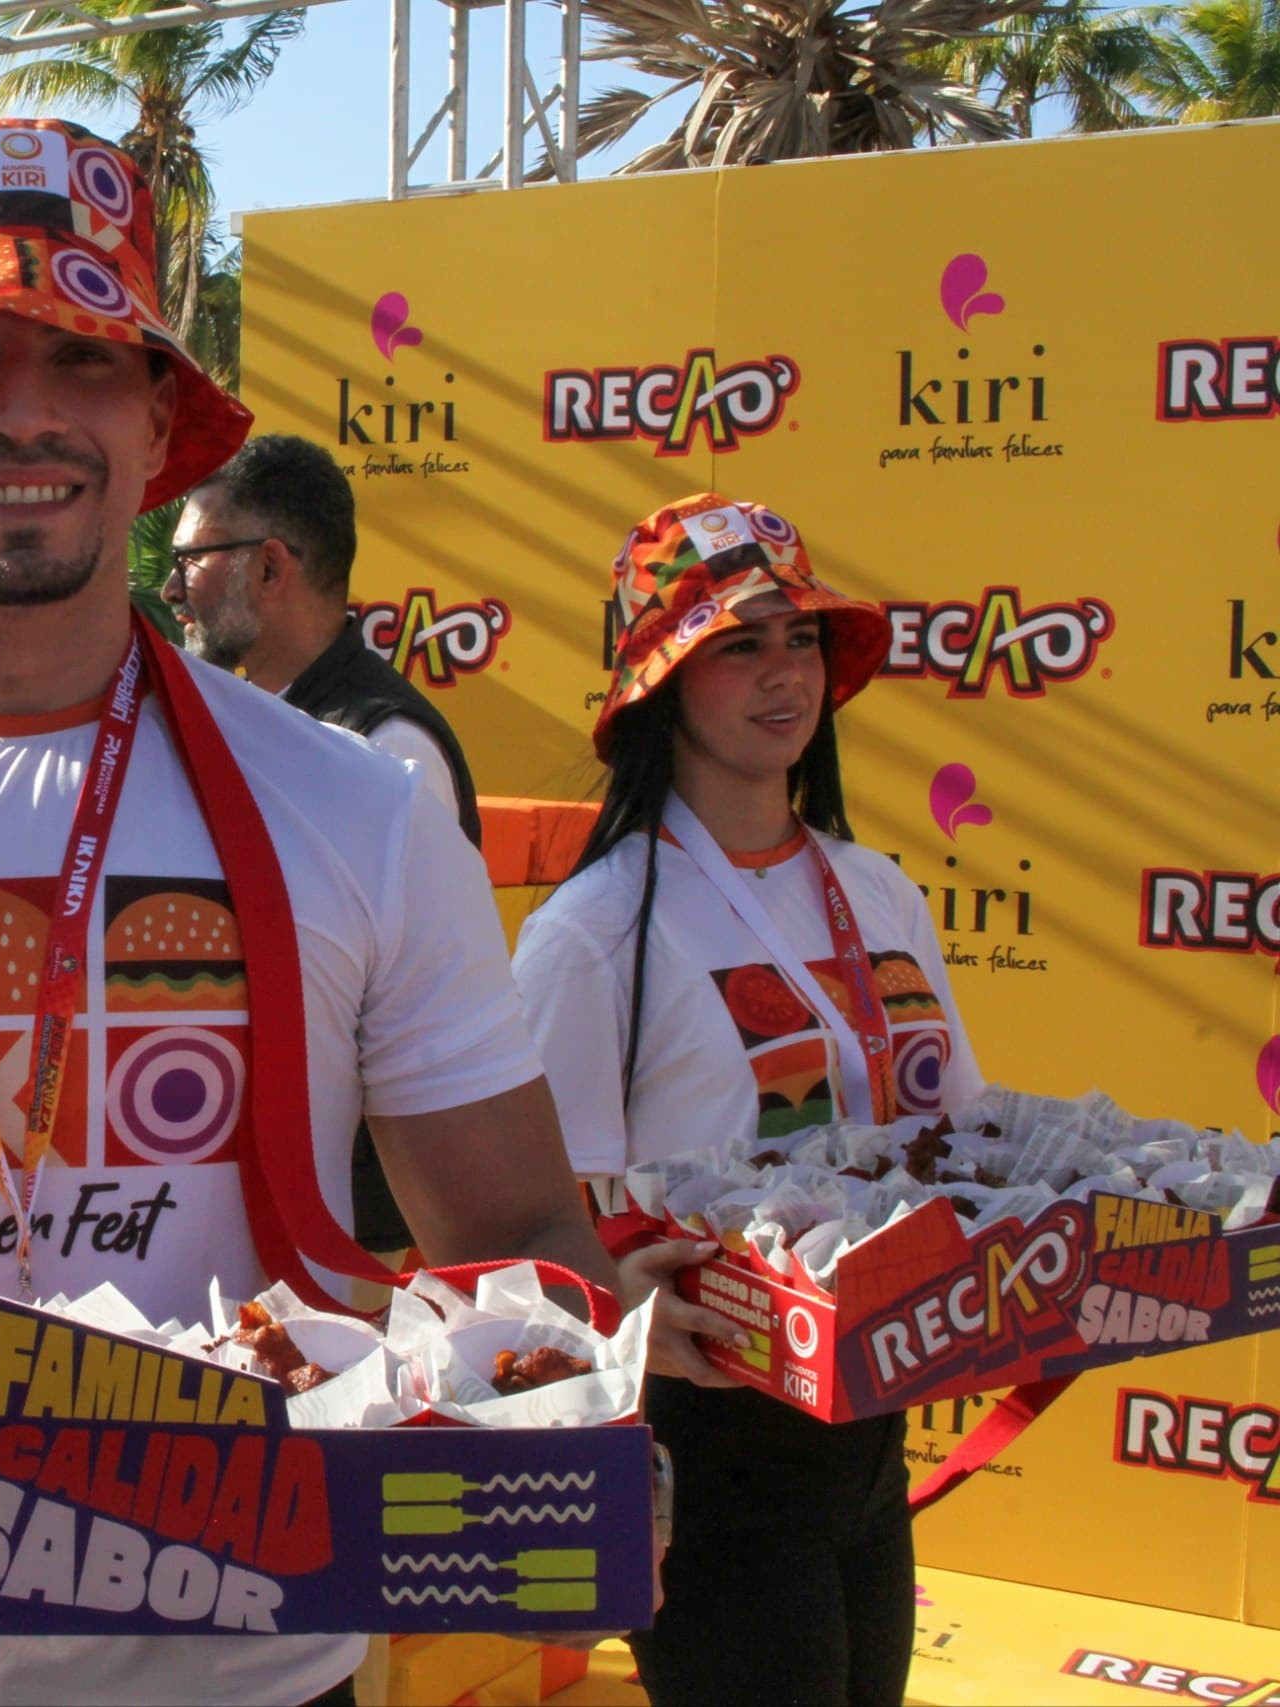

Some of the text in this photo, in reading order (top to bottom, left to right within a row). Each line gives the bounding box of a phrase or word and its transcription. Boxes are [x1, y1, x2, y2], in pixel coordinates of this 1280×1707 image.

[1, 171, 46, 187] KIRI
[335, 372, 458, 447] kiri
[895, 343, 1049, 427] kiri
[361, 453, 414, 480] familias
[420, 451, 470, 479] felices
[879, 433, 1065, 468] para familias felices
[1205, 702, 1252, 723] para
[916, 855, 1034, 936] iri
[986, 944, 1048, 973] felices
[60, 1181, 177, 1261] Fest
[1095, 1194, 1211, 1253] FAMILIA
[699, 1267, 772, 1312] HECHO EN
[1098, 1239, 1230, 1310] CALIDAD
[1078, 1284, 1212, 1346] SABOR
[783, 1371, 818, 1408] KIRI
[1127, 1397, 1280, 1490] REC
